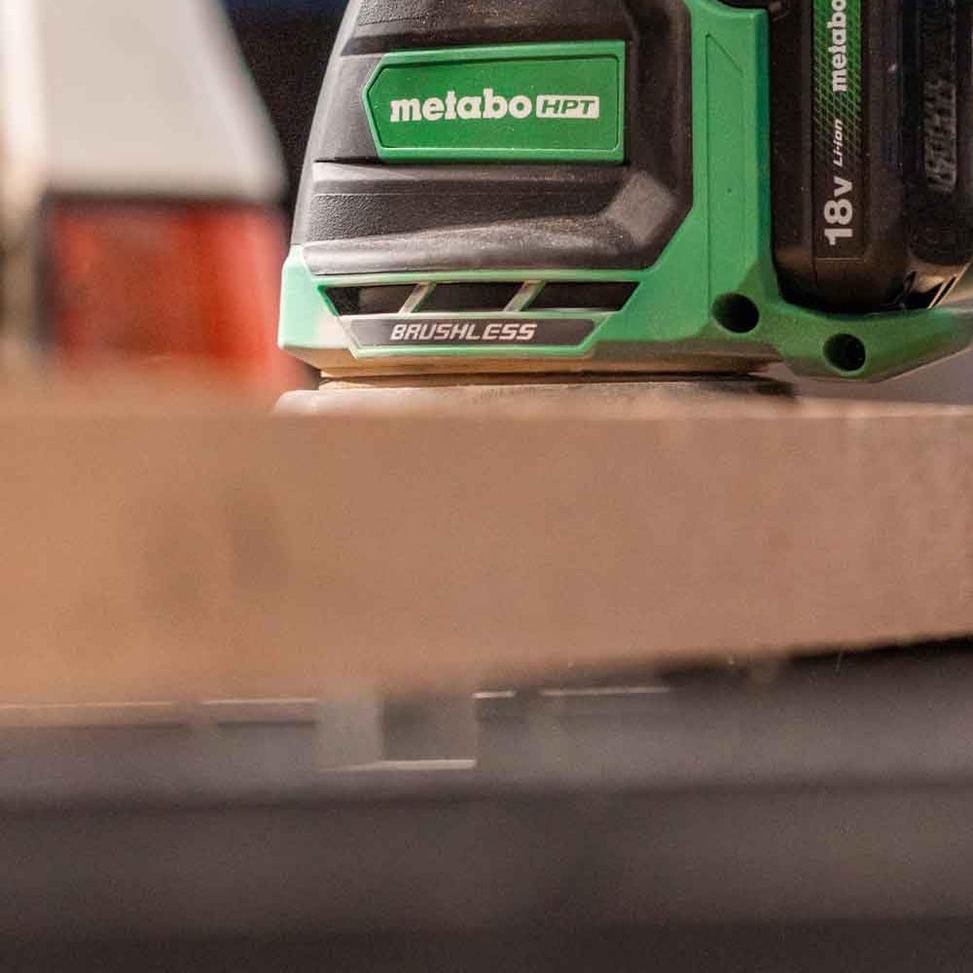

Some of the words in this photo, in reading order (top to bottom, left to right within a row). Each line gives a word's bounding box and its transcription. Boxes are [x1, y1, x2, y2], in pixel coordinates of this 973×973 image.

[390, 88, 532, 122] metabo
[538, 98, 597, 116] HPT
[390, 323, 538, 341] BRUSHLESS
